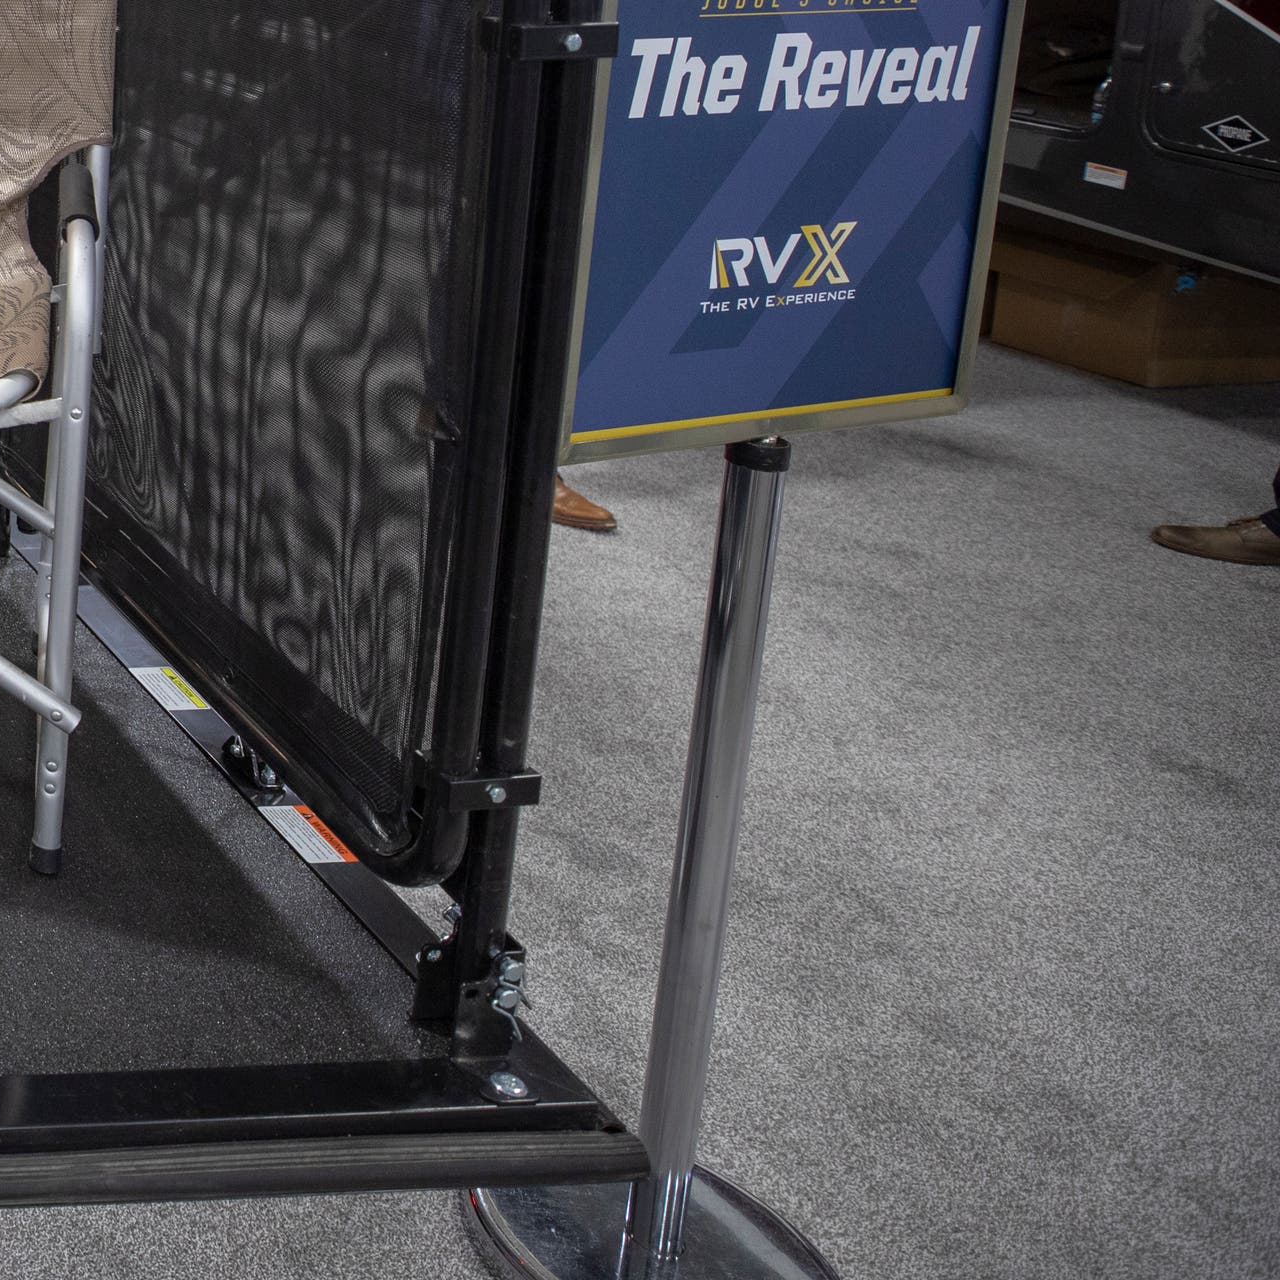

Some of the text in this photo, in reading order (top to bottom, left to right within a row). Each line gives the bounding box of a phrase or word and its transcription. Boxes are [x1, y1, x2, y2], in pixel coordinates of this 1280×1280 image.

[628, 25, 981, 119] The Reveal
[709, 221, 858, 290] RVX
[737, 297, 759, 311] RV
